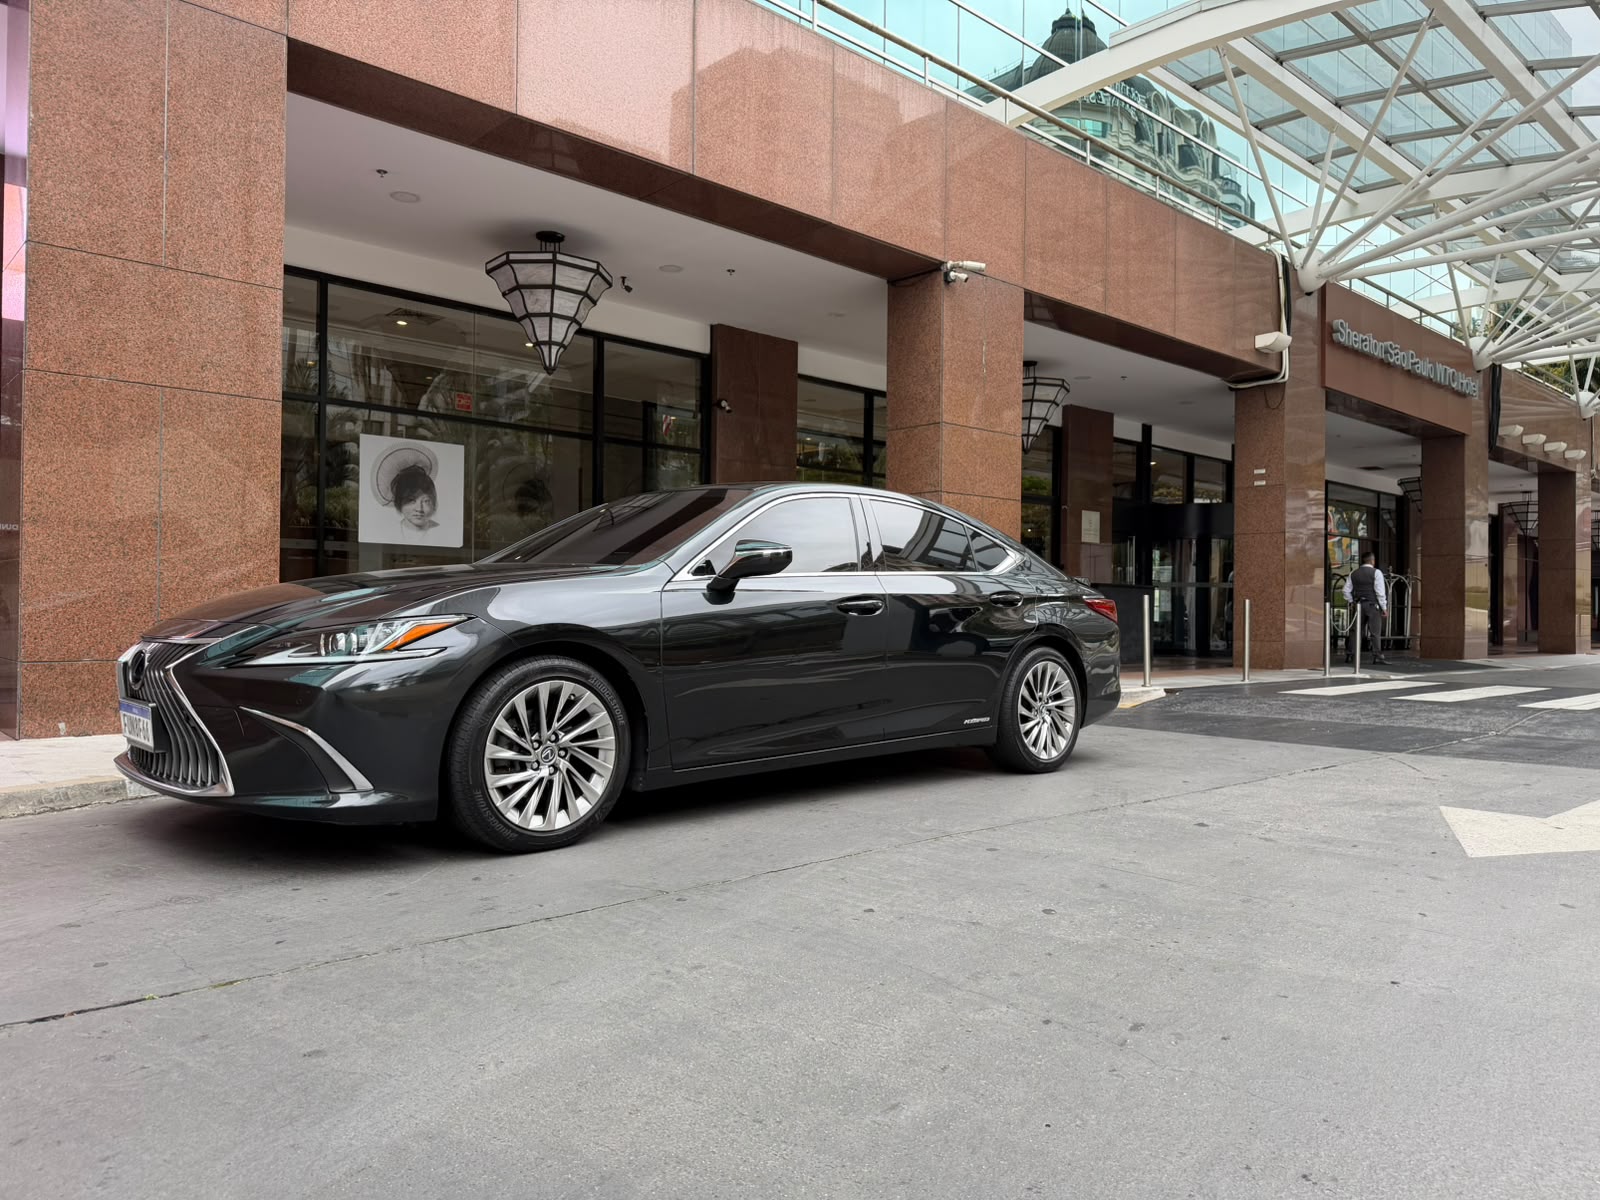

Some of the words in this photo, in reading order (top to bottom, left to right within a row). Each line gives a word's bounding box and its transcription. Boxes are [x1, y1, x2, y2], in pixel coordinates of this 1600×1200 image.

[1333, 319, 1385, 360] Sheraton
[1387, 341, 1407, 368] São
[1408, 350, 1435, 380] Paulo
[1435, 362, 1457, 389] WTC
[1458, 371, 1480, 399] Hotel
